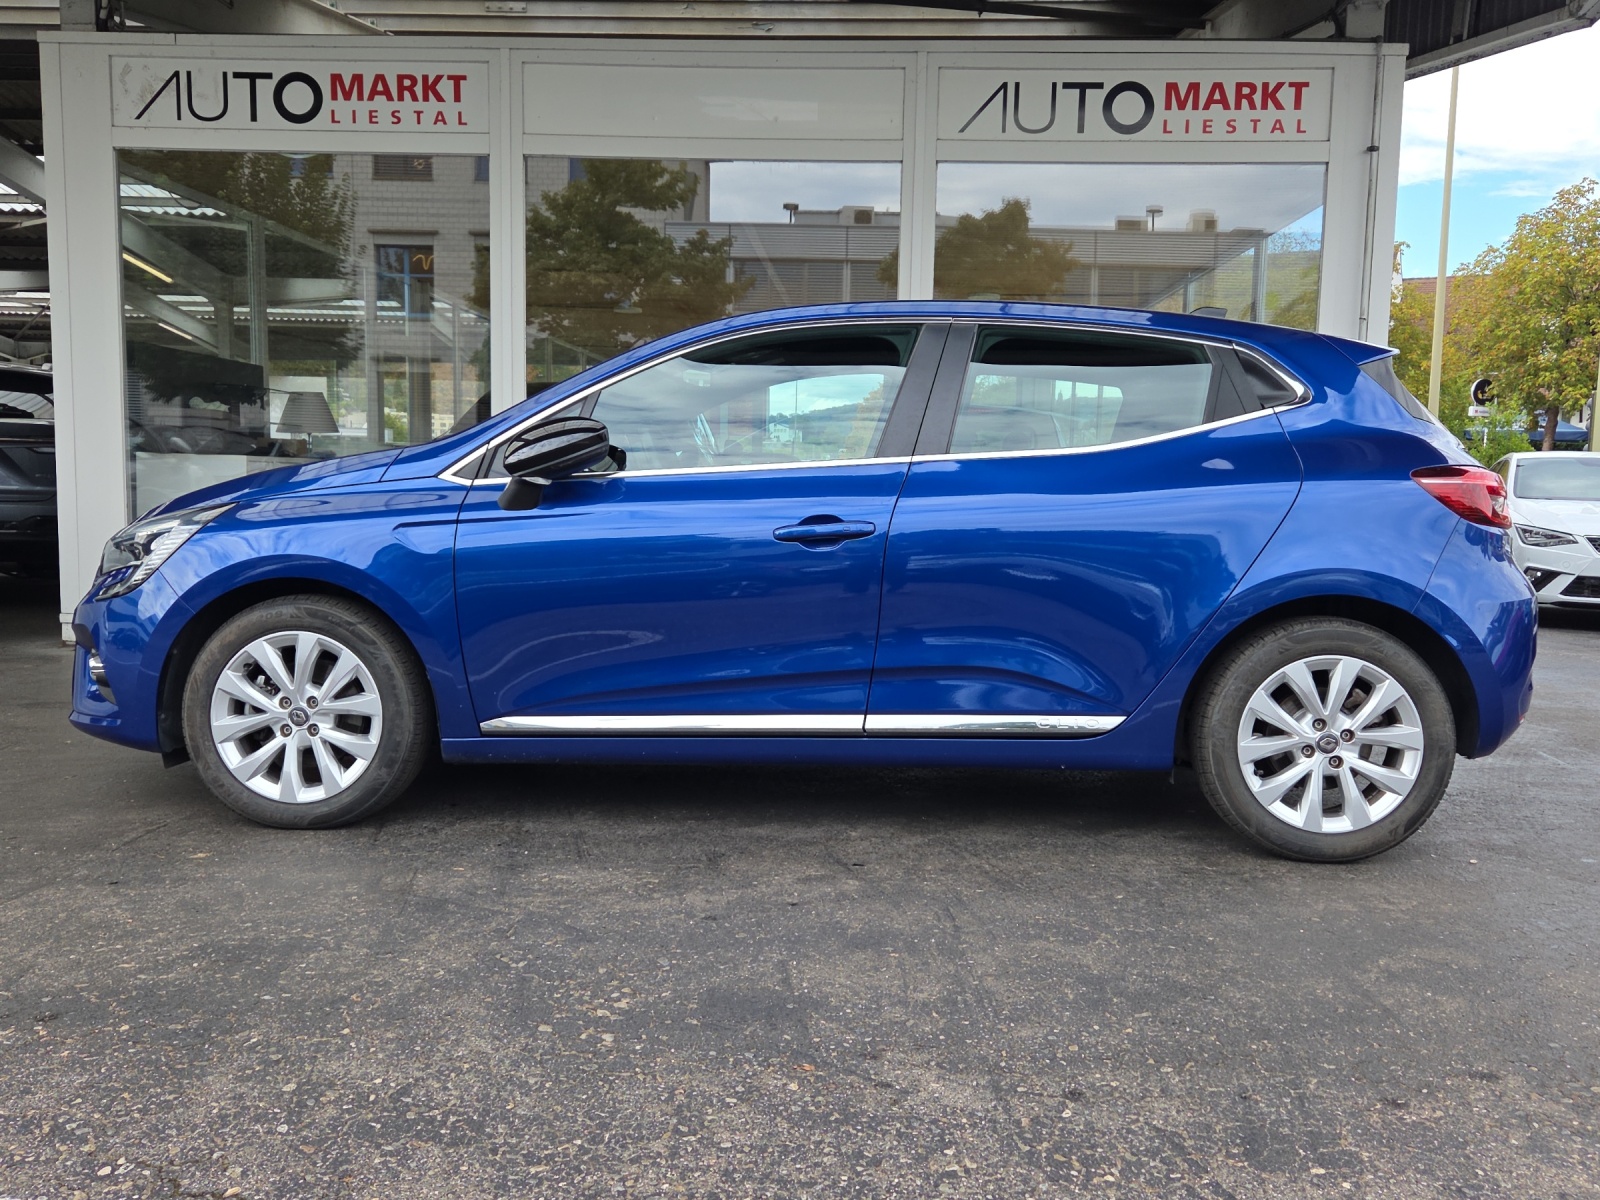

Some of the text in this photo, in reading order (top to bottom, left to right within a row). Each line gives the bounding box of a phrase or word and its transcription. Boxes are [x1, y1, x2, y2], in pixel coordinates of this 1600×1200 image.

[134, 70, 467, 124] AUTO MARKT
[958, 81, 1310, 135] AUTO MARKT
[331, 110, 467, 125] LIESTAL
[1163, 119, 1308, 135] LIESTAL
[1036, 718, 1100, 729] CLIO
